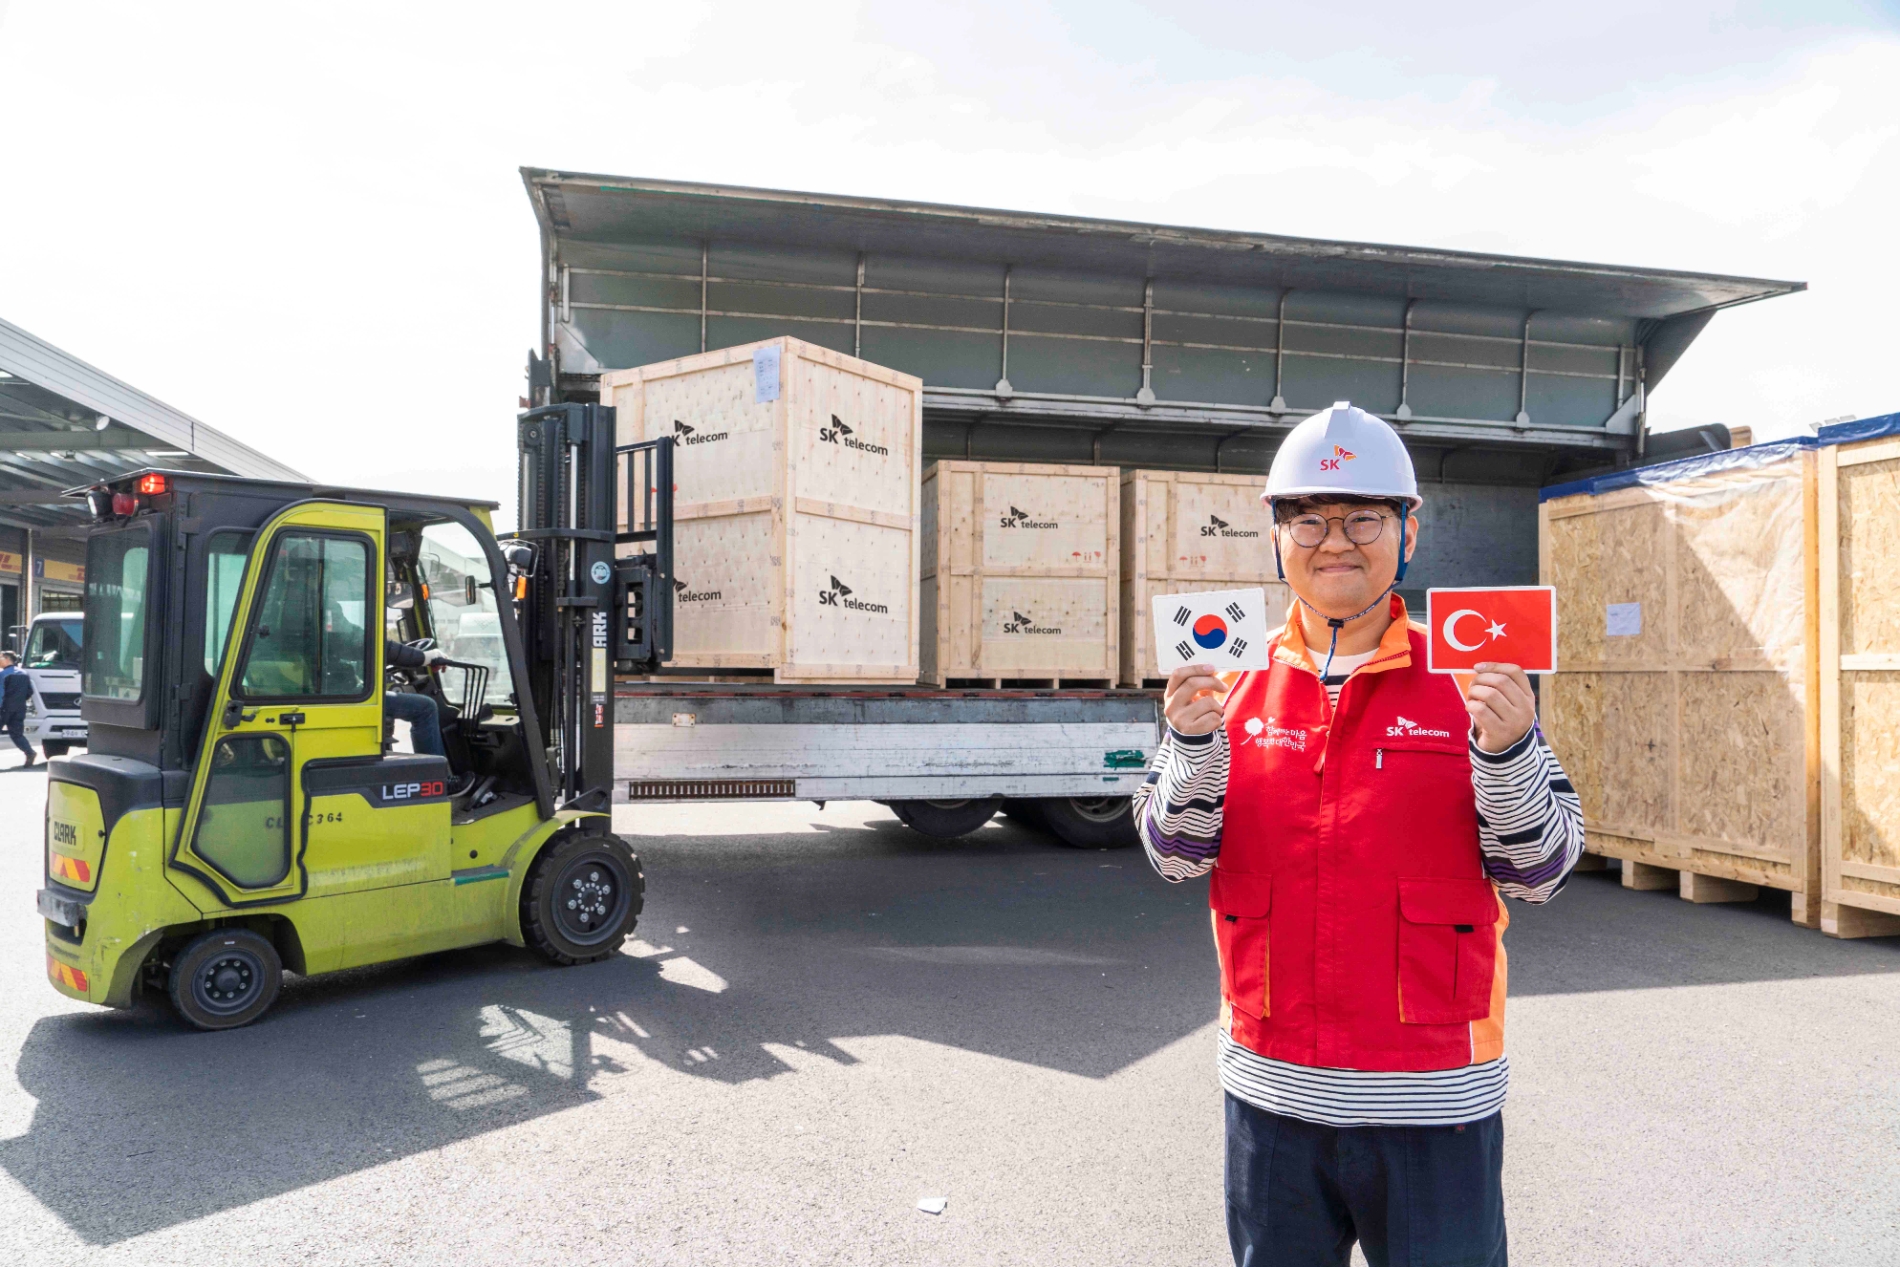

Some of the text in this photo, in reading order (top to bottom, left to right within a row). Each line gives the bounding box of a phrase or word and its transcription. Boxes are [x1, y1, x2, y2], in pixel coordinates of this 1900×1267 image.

[667, 432, 728, 447] K telecom
[820, 428, 888, 456] SK telecom
[1320, 459, 1340, 471] SK
[1000, 518, 1058, 529] SK telecom
[1200, 526, 1259, 538] SK telecom
[36, 560, 43, 575] 7
[678, 590, 722, 602] telecom
[819, 590, 888, 614] SK telecom
[1003, 623, 1061, 635] SK telecom
[1386, 726, 1450, 738] SK telecom
[382, 781, 444, 800] LEP30
[54, 820, 77, 846] CLARK
